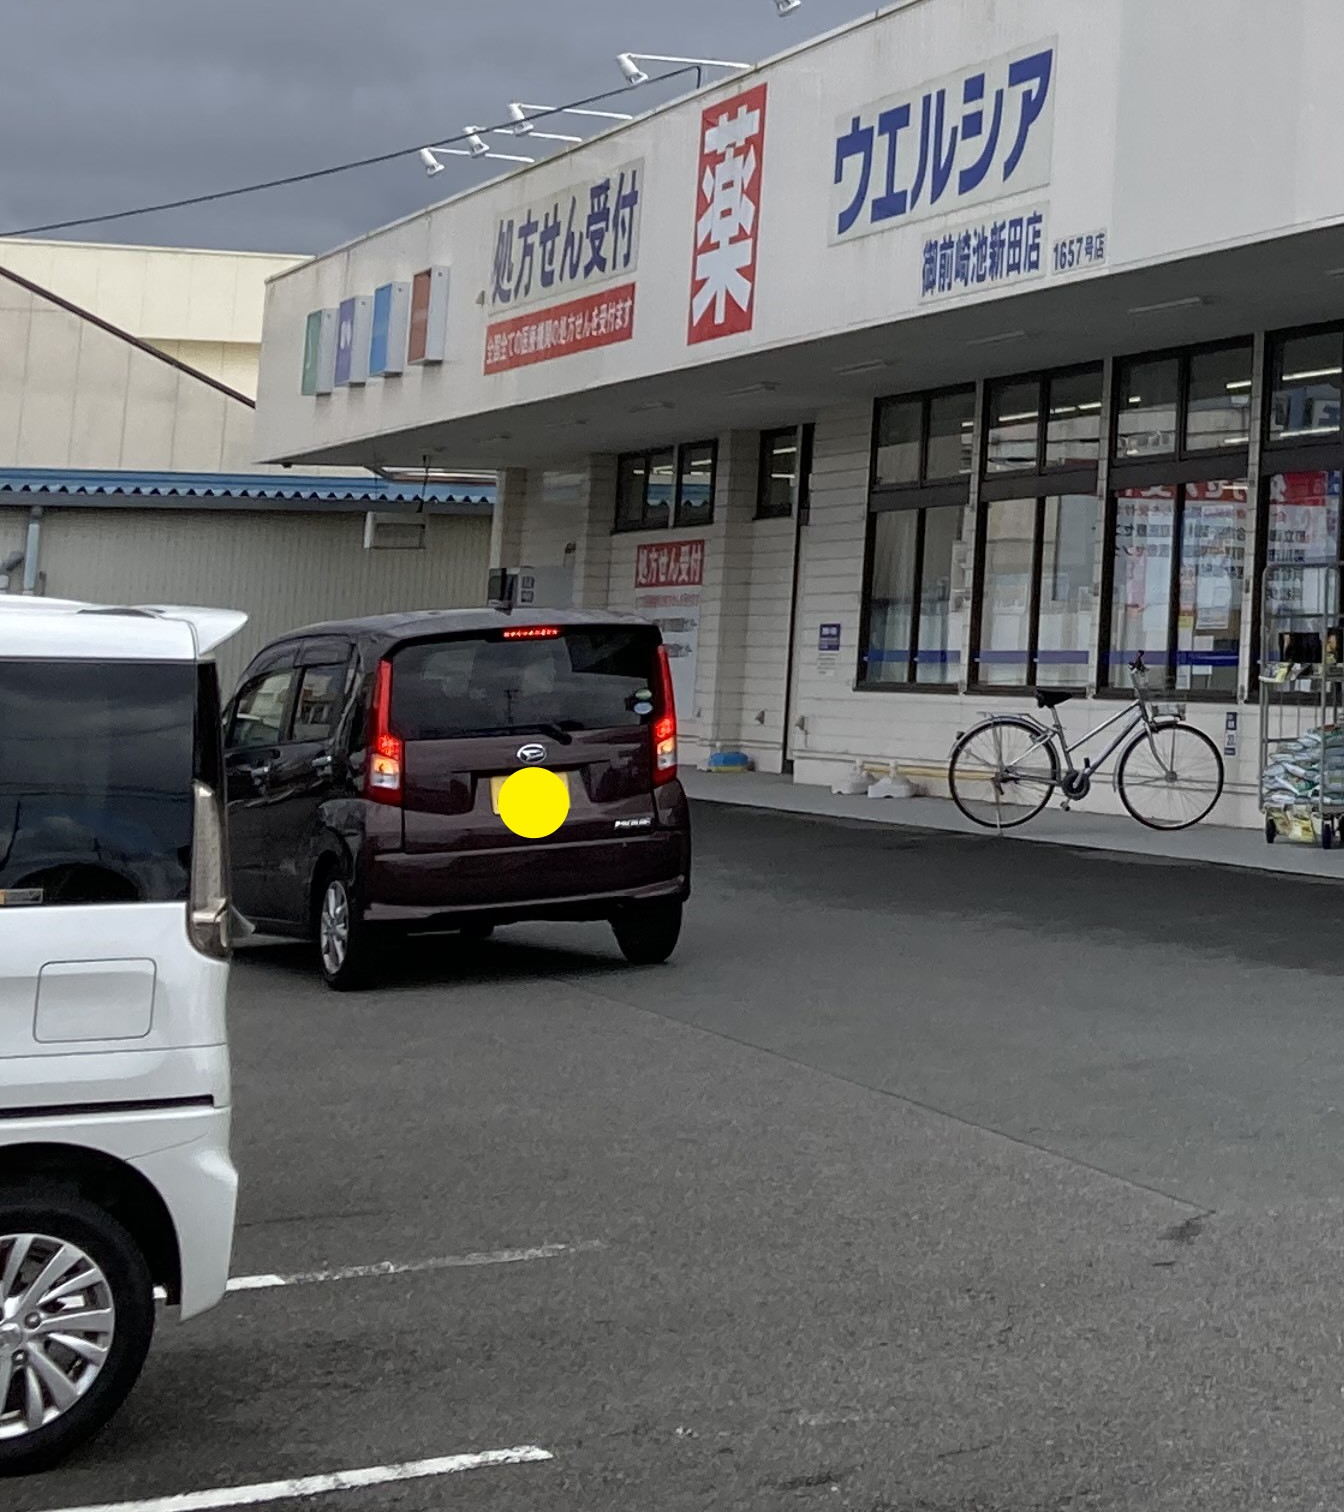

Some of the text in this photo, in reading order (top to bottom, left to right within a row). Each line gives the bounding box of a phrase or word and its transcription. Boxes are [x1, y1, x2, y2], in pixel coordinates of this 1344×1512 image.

[833, 48, 1054, 236] ウエルシア
[491, 170, 639, 306] 処方せん受付
[692, 104, 763, 325] 薬
[1053, 233, 1106, 271] 1657号店
[637, 540, 702, 585] 処方せん受付
